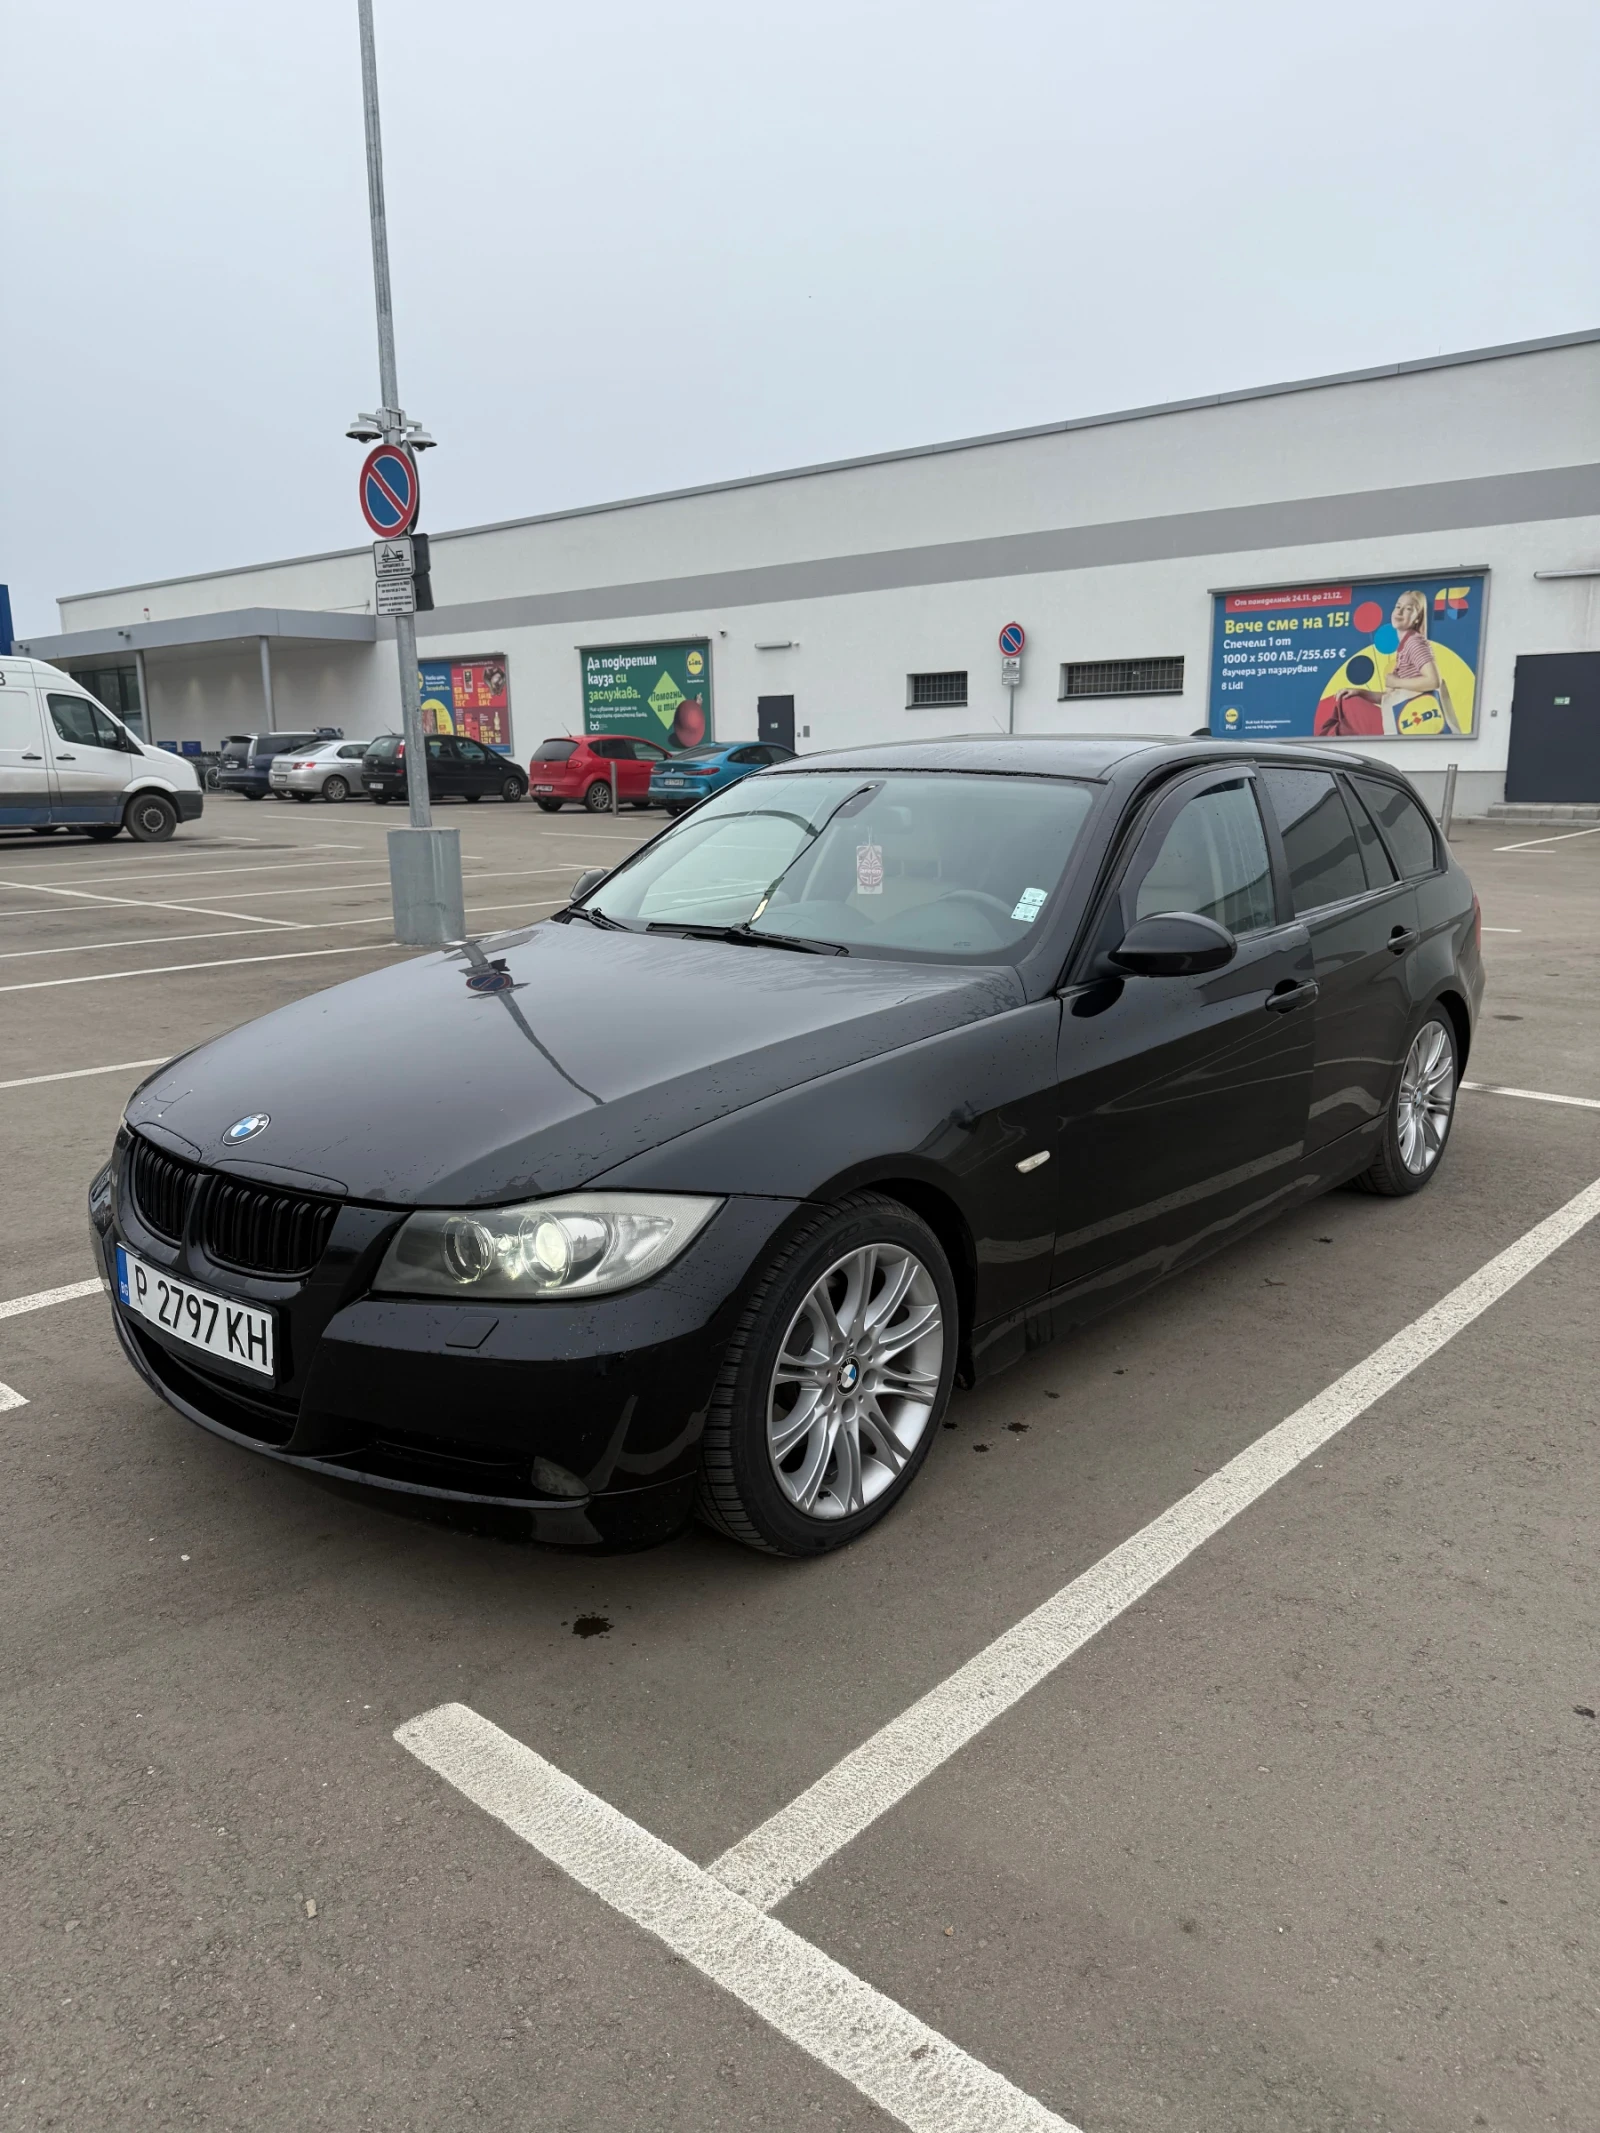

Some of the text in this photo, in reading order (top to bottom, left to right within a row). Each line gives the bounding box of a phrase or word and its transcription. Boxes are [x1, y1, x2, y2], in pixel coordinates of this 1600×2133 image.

[1234, 591, 1342, 607] От понеделник 24.11. до 21.12.
[1224, 611, 1350, 634] Вече сме на 15!
[1223, 637, 1291, 649] Спечели 1 от
[587, 655, 657, 671] Да подкрепим
[1222, 653, 1248, 664] 1000
[1257, 651, 1277, 662] 500
[1278, 648, 1337, 662] ЛВ./255.65
[1338, 648, 1347, 658] €
[1222, 664, 1318, 678] ваучера за пазаруване
[588, 672, 627, 687] кауза си
[1221, 681, 1244, 690] в Lidl
[588, 686, 641, 704] заслужава.
[650, 691, 682, 702] Помогни
[657, 704, 662, 712] и
[120, 1280, 129, 1297] BG
[134, 1264, 269, 1366] P 2797 KH
